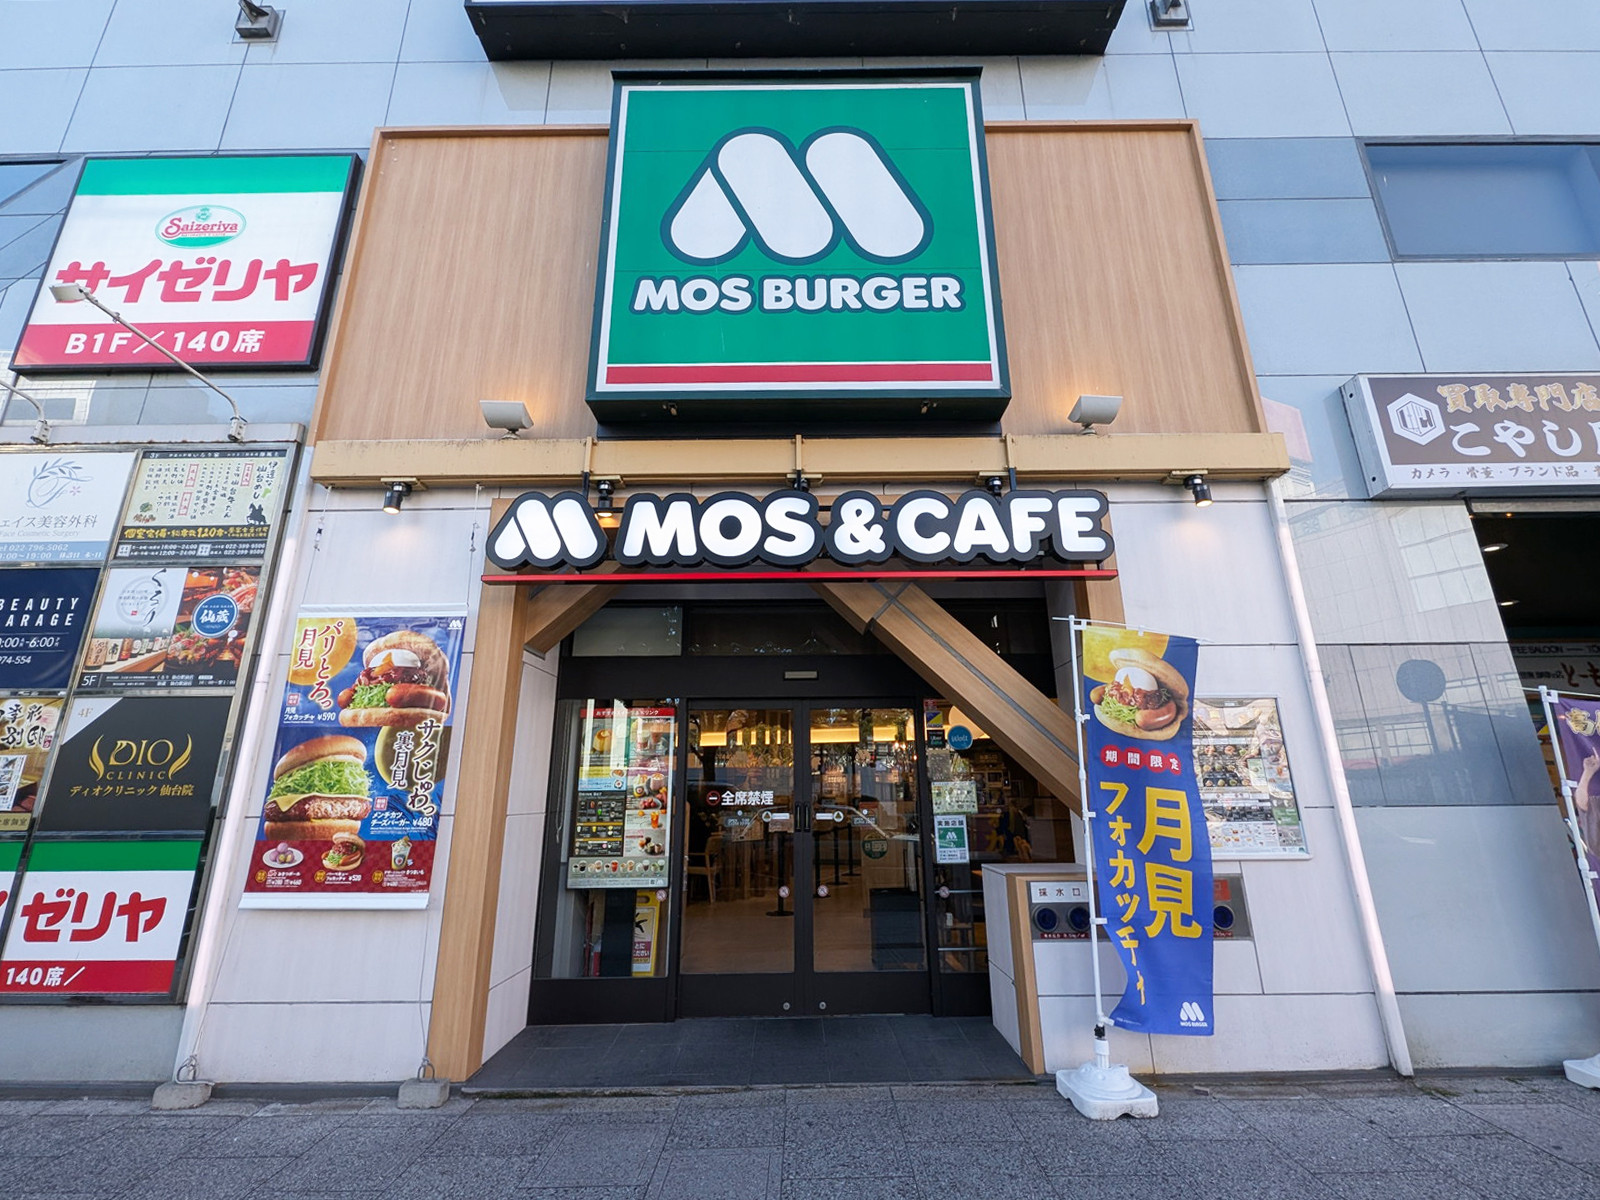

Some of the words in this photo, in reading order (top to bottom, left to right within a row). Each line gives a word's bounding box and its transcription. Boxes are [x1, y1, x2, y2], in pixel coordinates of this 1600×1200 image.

[161, 217, 239, 239] Saizeriya
[55, 256, 319, 304] サイゼリヤ
[634, 277, 752, 312] MOS
[762, 276, 962, 311] BURGER
[622, 497, 816, 558] MOS
[832, 498, 889, 557] &
[895, 496, 1107, 555] CAFE
[5, 613, 75, 627] ARAGE
[293, 628, 318, 669] 月見
[309, 621, 344, 709] パリとろっ
[81, 675, 97, 687] 5F
[78, 707, 94, 718] 4F
[317, 711, 336, 721] ¥590
[108, 739, 174, 766] DIO
[388, 731, 415, 788] 裏月見
[1104, 750, 1180, 772] 期間限定
[106, 771, 166, 780] CLINIC
[408, 719, 441, 815] サクじゅわっ
[70, 784, 158, 797] ディオクリニック
[159, 784, 194, 797] 仙台院
[721, 791, 774, 806] 全席禁煙
[1136, 786, 1203, 939] 月見
[20, 887, 168, 943] ゼリヤ
